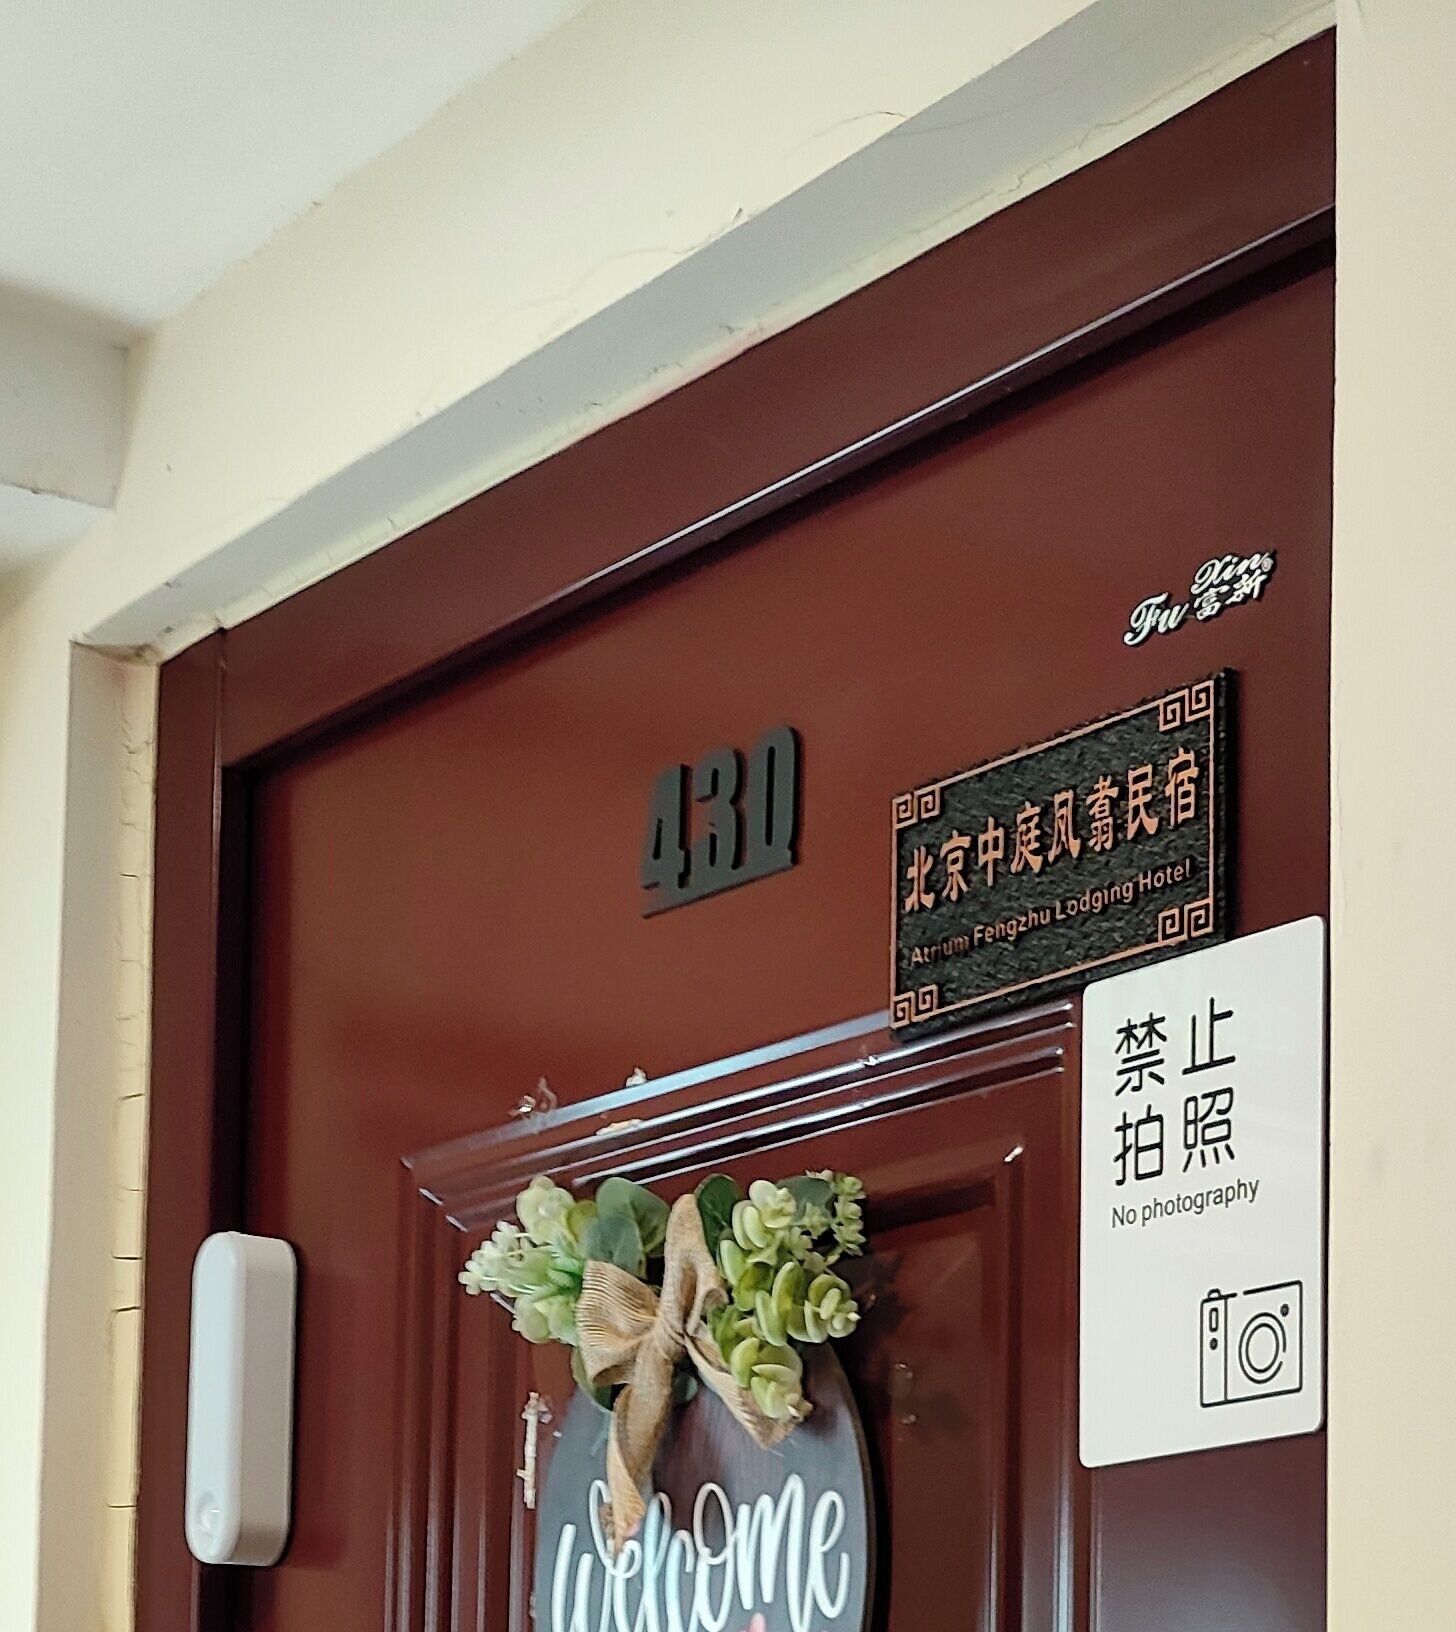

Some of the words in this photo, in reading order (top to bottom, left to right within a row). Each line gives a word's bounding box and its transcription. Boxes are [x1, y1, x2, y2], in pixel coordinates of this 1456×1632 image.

[1123, 591, 1190, 646] Fu
[1193, 568, 1268, 621] 富新
[640, 724, 802, 912] 430
[904, 746, 1200, 913] 北京中庭凤翥民宿
[909, 934, 970, 970] Atrium
[972, 907, 1051, 947] Fengzhu
[1054, 880, 1134, 921] Lodging
[1138, 856, 1191, 893] Hotel
[1114, 996, 1237, 1098] 禁止
[1113, 1085, 1236, 1187] 拍照
[1111, 1204, 1138, 1229] No
[1141, 1177, 1260, 1228] photography
